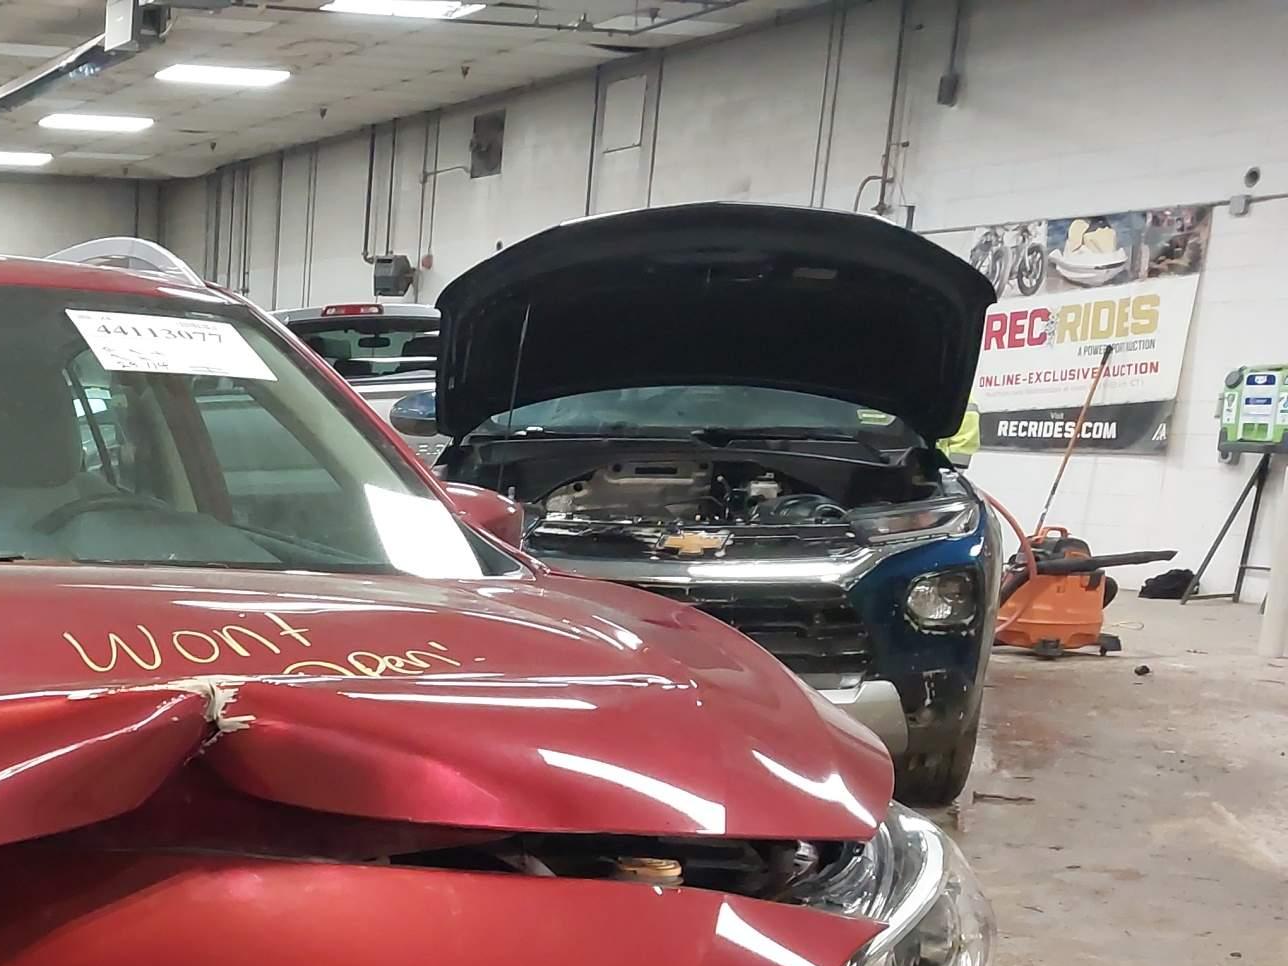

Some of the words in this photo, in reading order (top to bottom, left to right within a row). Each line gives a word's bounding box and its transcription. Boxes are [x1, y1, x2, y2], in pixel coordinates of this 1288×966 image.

[96, 323, 223, 344] 44113077
[979, 367, 1099, 388] ONLINE-EXCLUSIVE
[1102, 361, 1159, 378] AUCTION
[997, 420, 1117, 439] RECRIDES.COM
